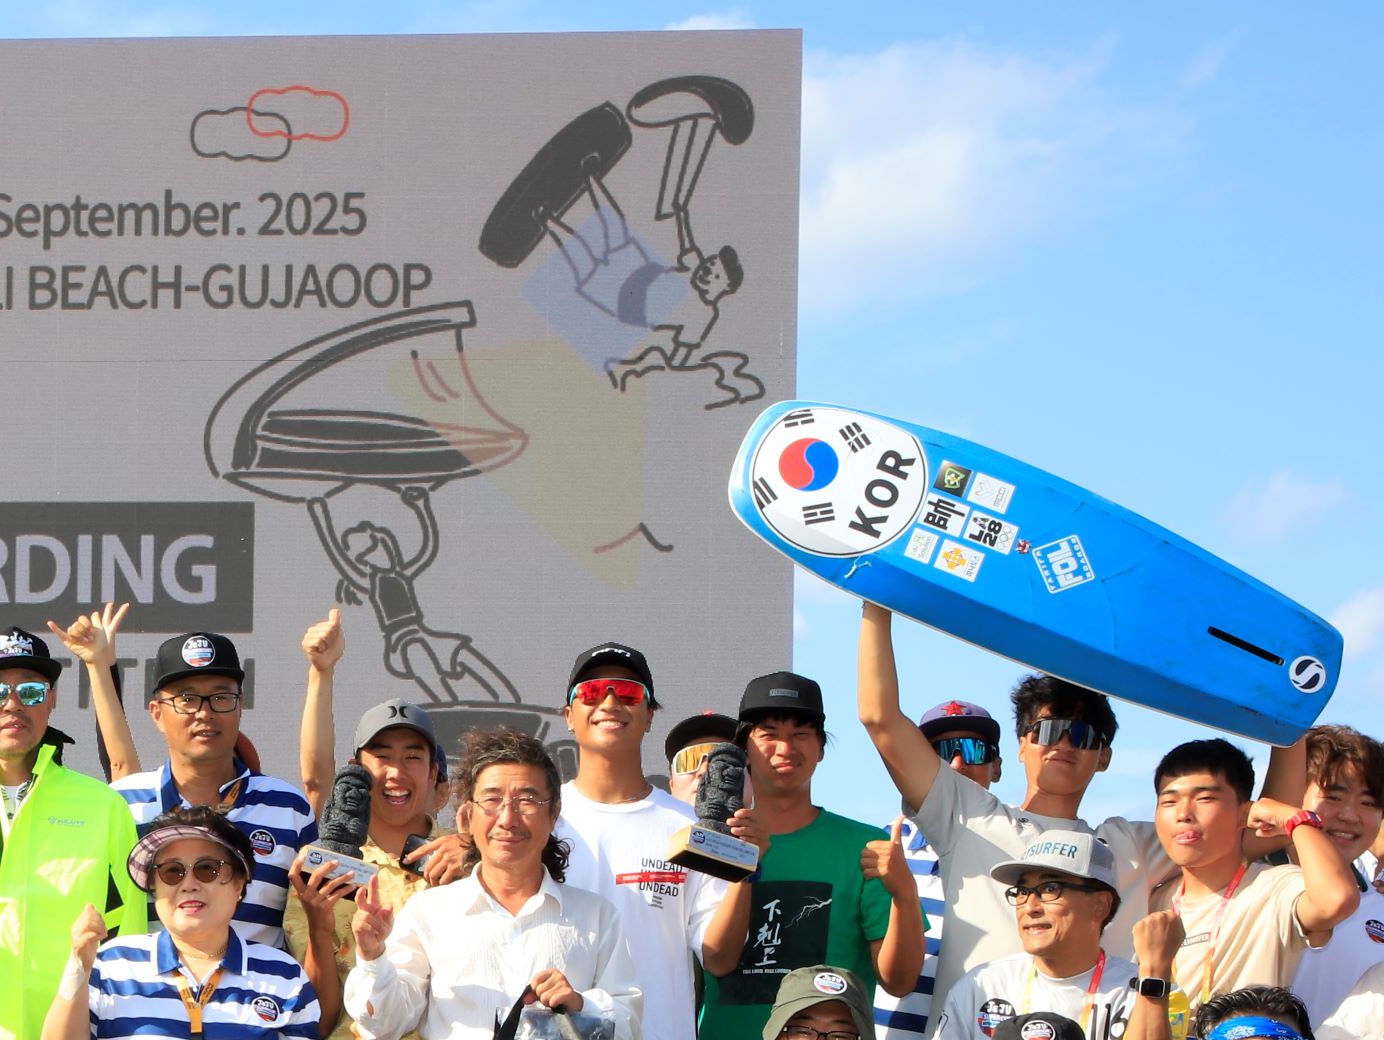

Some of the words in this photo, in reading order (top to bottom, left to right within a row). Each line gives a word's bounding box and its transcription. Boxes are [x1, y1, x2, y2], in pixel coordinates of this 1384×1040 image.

[258, 190, 367, 236] 2025
[28, 262, 432, 309] BEACH-GUJAOOP
[848, 450, 916, 539] KOR
[969, 516, 990, 542] LA
[982, 519, 1003, 548] 28
[1047, 541, 1084, 588] FOIL
[638, 881, 679, 897] UNDEAD
